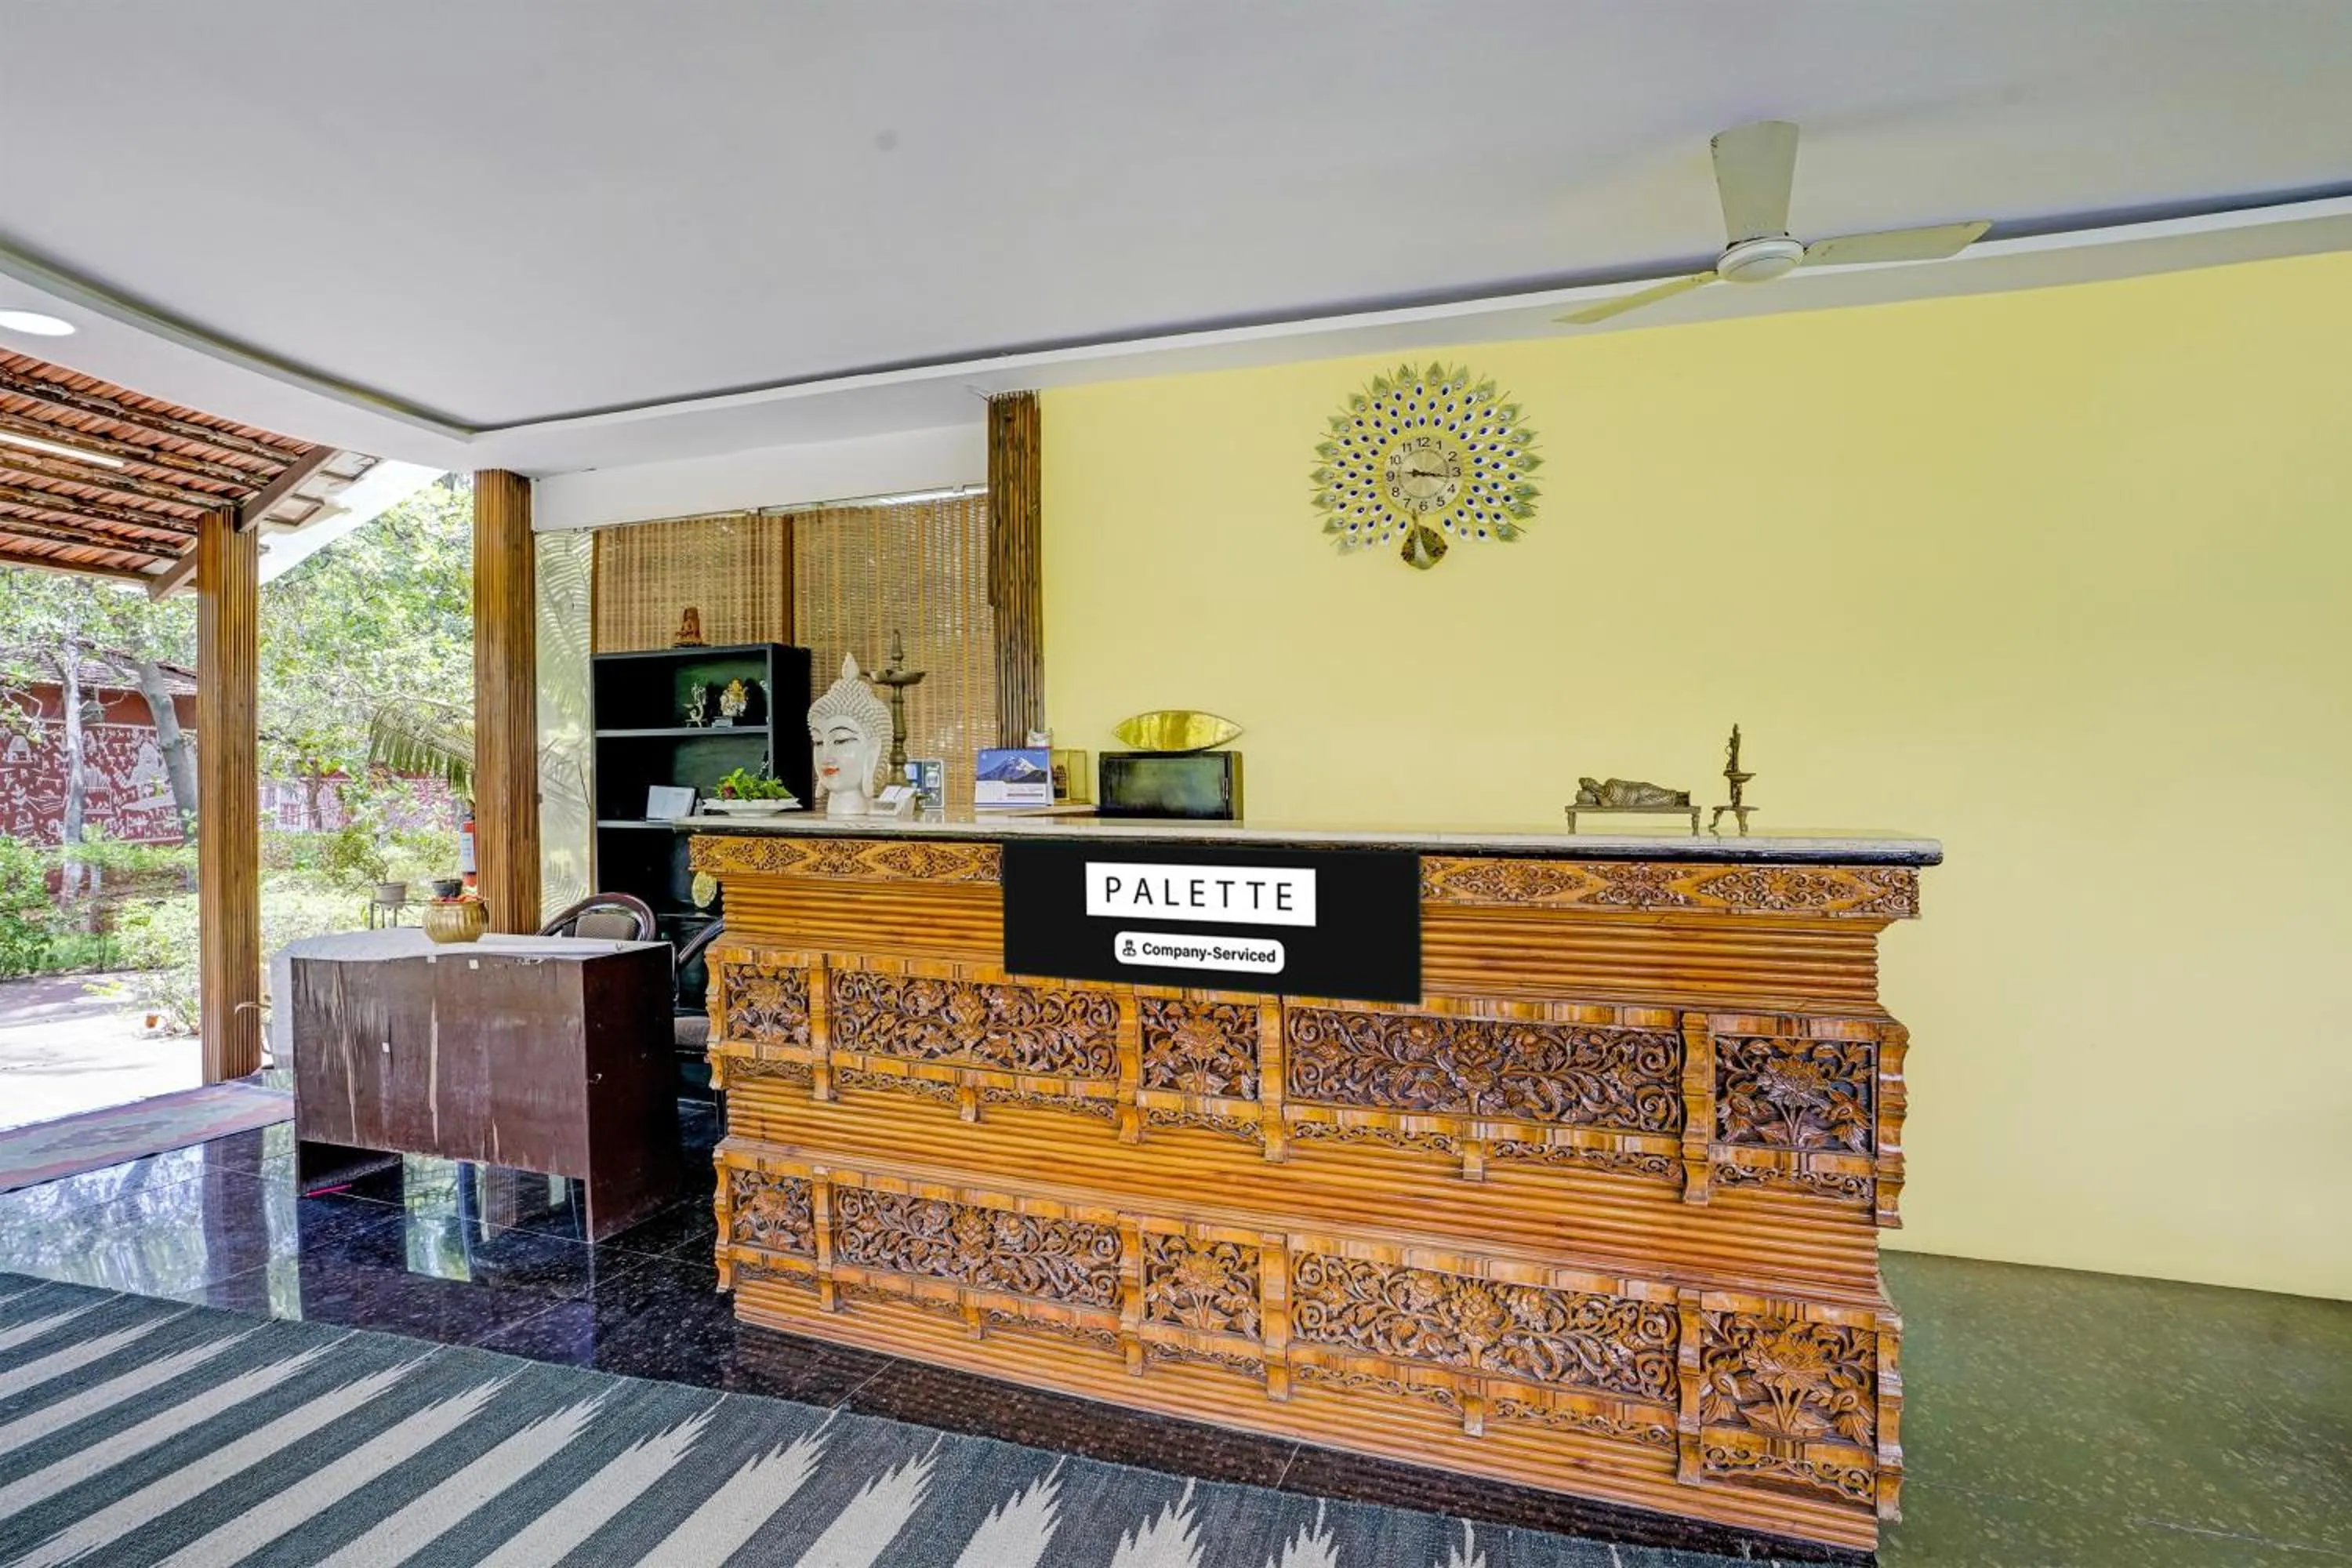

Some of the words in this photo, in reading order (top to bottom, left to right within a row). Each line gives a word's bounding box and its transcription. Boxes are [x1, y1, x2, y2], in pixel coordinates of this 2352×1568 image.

[1402, 442, 1412, 452] 11
[1416, 437, 1430, 448] 12
[1436, 440, 1442, 450] 1
[1389, 455, 1401, 465] 10
[1448, 451, 1457, 463] 2
[1385, 470, 1395, 482] 9
[1451, 466, 1461, 477] 3
[1392, 487, 1400, 498] 8
[1447, 484, 1455, 493] 4
[1403, 498, 1411, 509] 7
[1419, 501, 1428, 511] 6
[1436, 496, 1445, 507] 5
[1105, 877, 1293, 911] PALETTE
[1142, 942, 1276, 964] Company-Serviced
